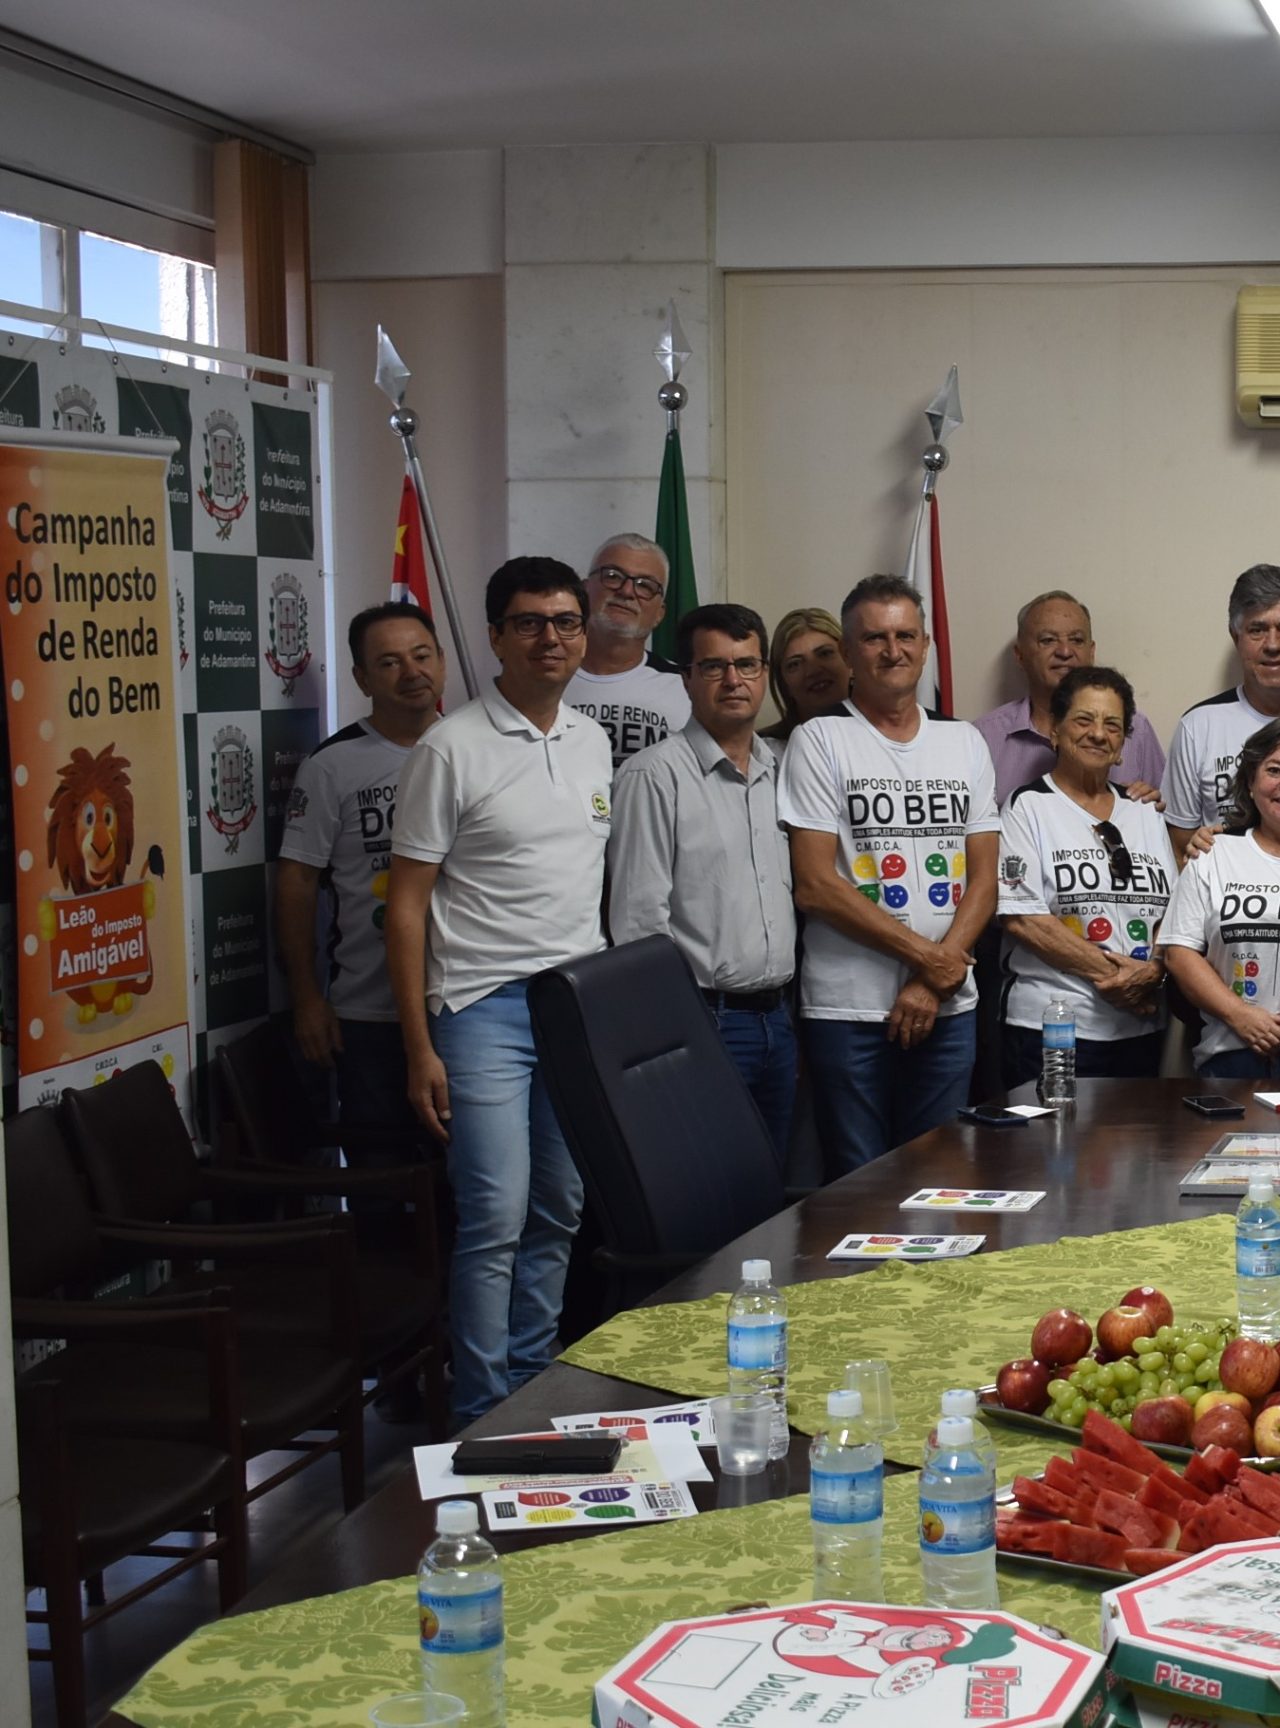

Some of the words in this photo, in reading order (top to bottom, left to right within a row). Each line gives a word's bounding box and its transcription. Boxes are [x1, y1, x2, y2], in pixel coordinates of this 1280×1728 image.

[262, 472, 273, 487] do
[259, 499, 270, 512] de
[16, 502, 155, 555] Campanha
[6, 560, 42, 603] do
[54, 562, 156, 612] Imposto
[208, 600, 246, 616] Prefeitura
[38, 619, 76, 662] de
[83, 616, 158, 660] Renda
[203, 626, 214, 642] do
[200, 653, 211, 669] de
[211, 653, 257, 669] Adamantina
[69, 675, 100, 718] do
[108, 676, 160, 715] Bem
[601, 705, 619, 721] DE
[624, 706, 669, 731] RENDA
[846, 778, 902, 792] IMPOSTO
[905, 780, 923, 792] DE
[926, 779, 970, 792] RENDA
[847, 793, 894, 826] DO
[904, 793, 970, 825] BEM
[891, 828, 914, 836] ATITUDE
[914, 828, 925, 836] FAZ
[856, 841, 902, 852] C.M.D.C.A.
[1052, 849, 1105, 863] IMPOSTO
[1131, 852, 1162, 867] ENDA
[1054, 862, 1100, 893] DO
[1225, 882, 1280, 893] IMPOSTO
[59, 904, 97, 930] Leão
[1220, 894, 1267, 921] DO
[91, 923, 104, 938] do
[105, 913, 142, 935] Imposto
[1255, 928, 1279, 938] ATITUDE
[57, 930, 144, 979] Amigável
[212, 945, 224, 960] do
[209, 970, 220, 987] de
[1217, 1583, 1271, 1602] Pizza
[1154, 1661, 1223, 1700] Pizza
[964, 1664, 1022, 1719] Pizza
[788, 1692, 822, 1713] mais
[817, 1700, 862, 1724] Pizza
